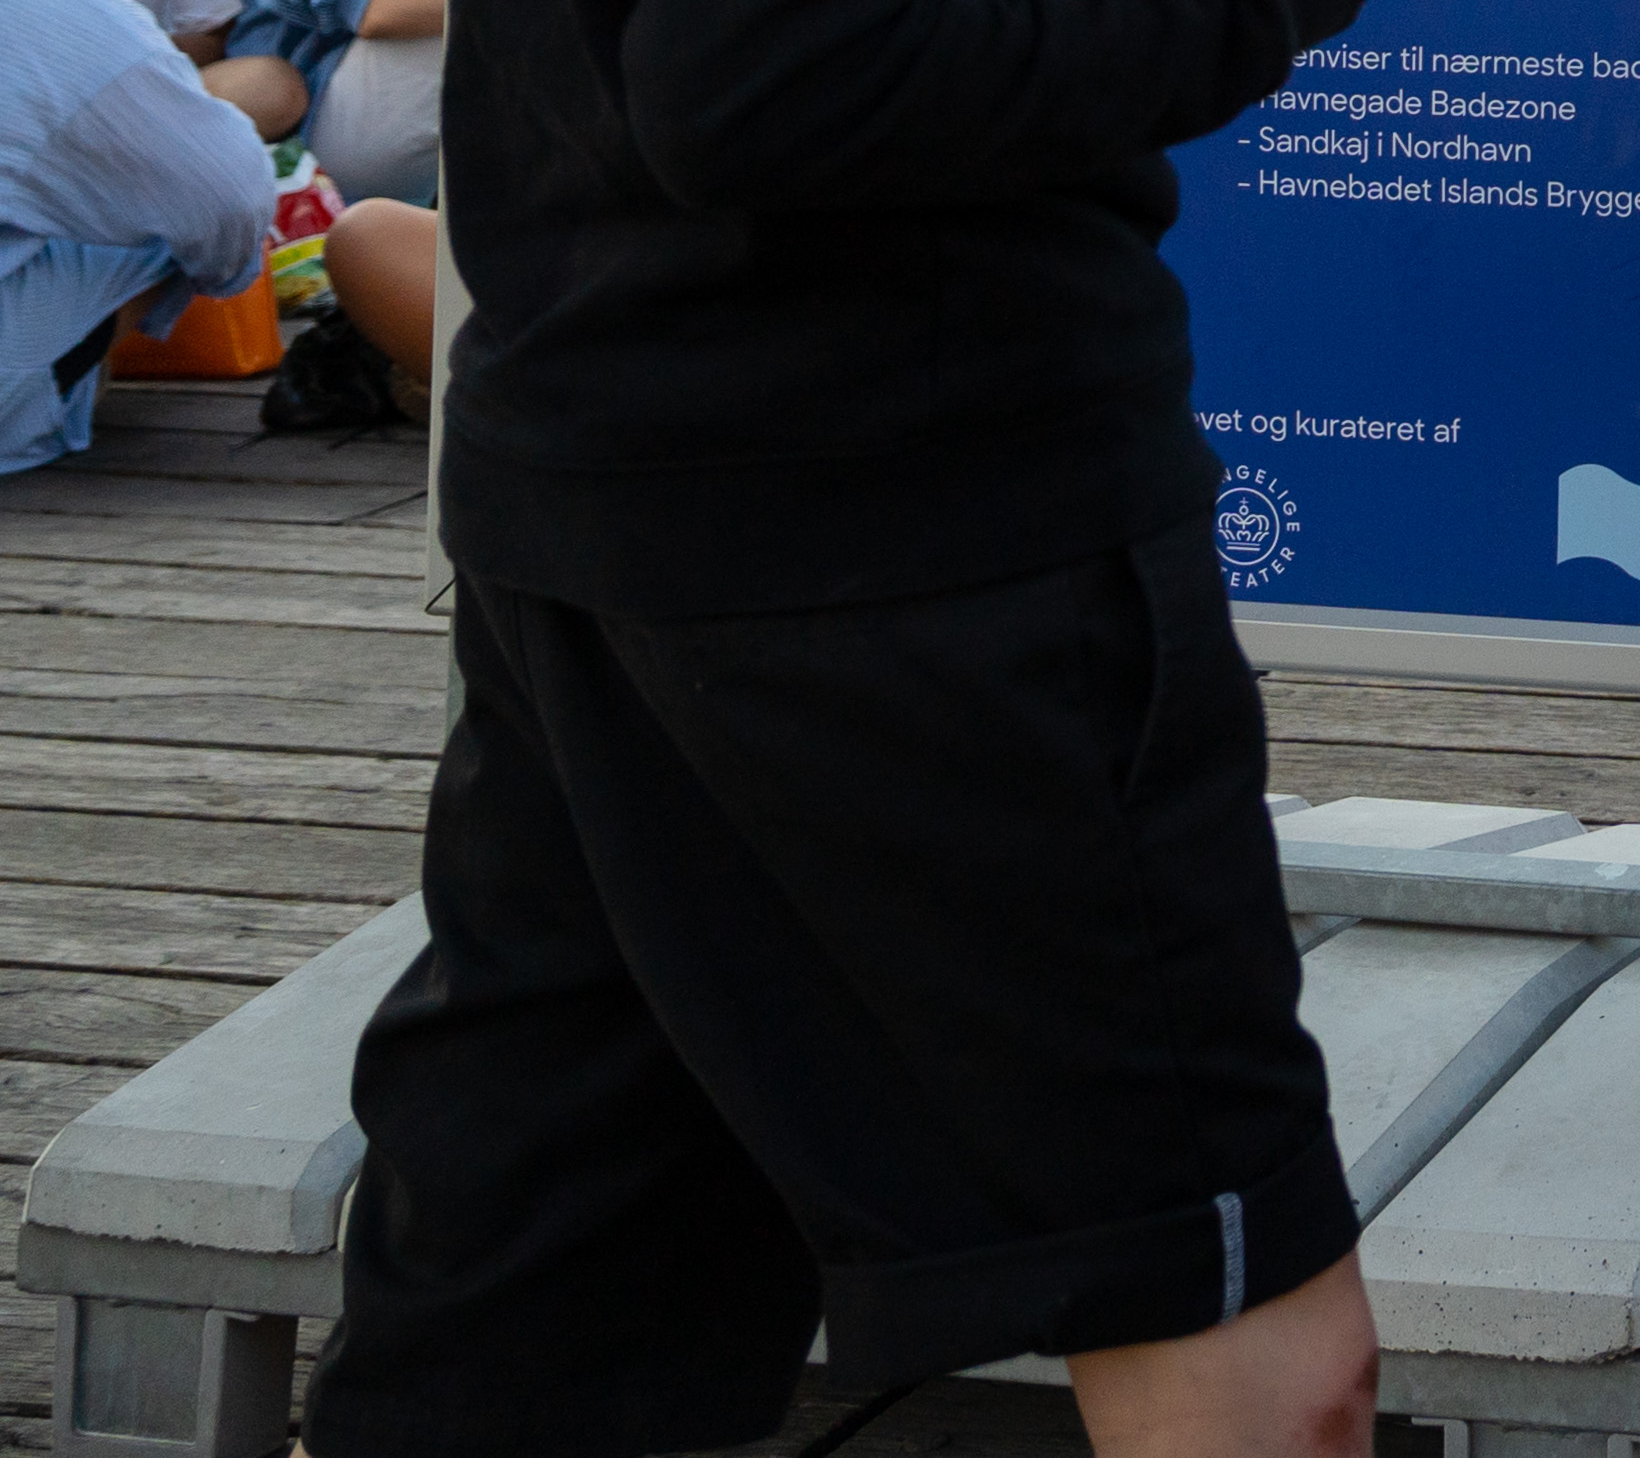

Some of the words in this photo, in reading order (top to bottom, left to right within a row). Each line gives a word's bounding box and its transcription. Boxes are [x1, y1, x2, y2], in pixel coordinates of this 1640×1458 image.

[1400, 45, 1423, 72] til
[1432, 53, 1584, 78] nærmeste
[1431, 89, 1576, 121] Badezone
[1259, 126, 1369, 164] Sandkaj
[1376, 131, 1383, 157] i
[1391, 131, 1532, 163] Nordhavn
[1259, 169, 1432, 202] Havnebadet
[1441, 177, 1539, 207] Islands
[1194, 409, 1243, 432] vet
[1250, 414, 1287, 442] og
[1296, 409, 1426, 442] kurateret
[1433, 417, 1462, 443] af
